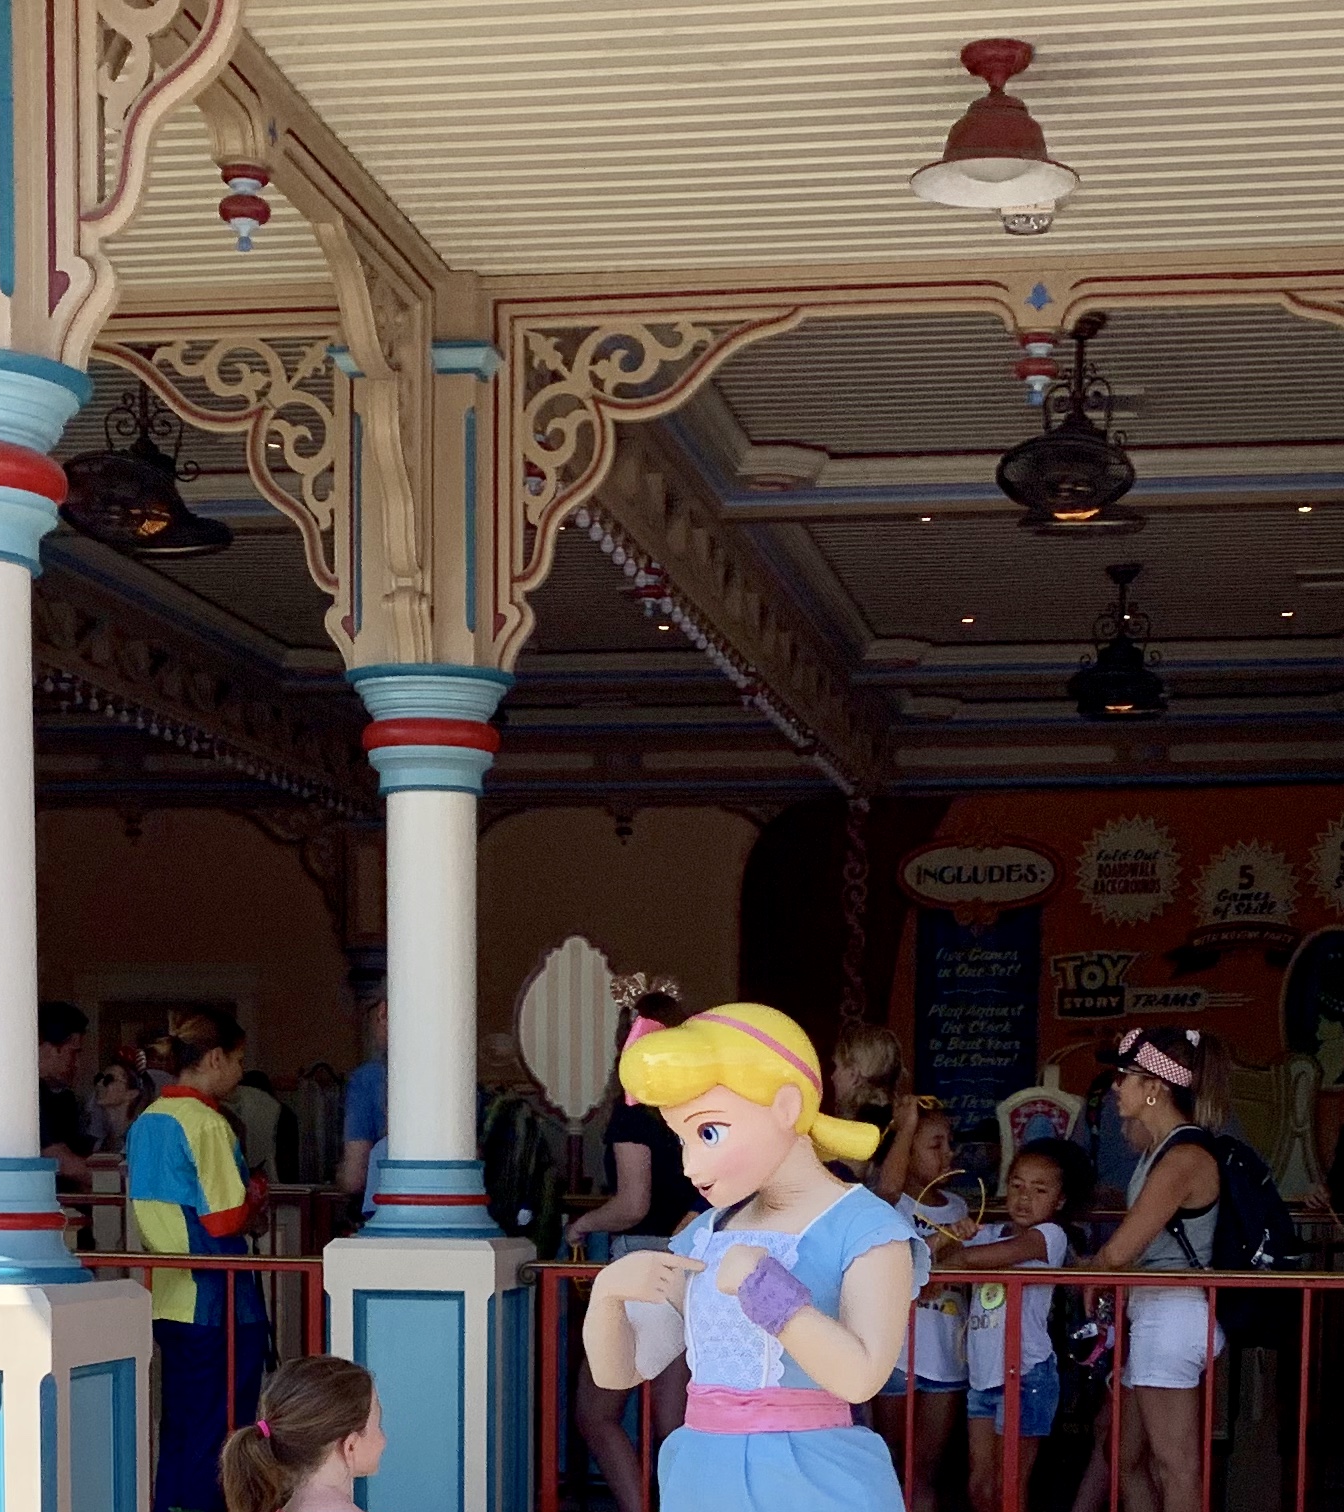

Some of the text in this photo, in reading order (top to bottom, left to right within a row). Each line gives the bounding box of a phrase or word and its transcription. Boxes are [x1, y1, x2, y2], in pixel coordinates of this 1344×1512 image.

[916, 863, 1046, 885] INCLUDES:
[1237, 865, 1255, 890] 5
[1217, 889, 1272, 902] Games
[1212, 901, 1278, 919] of Skill
[1056, 955, 1130, 990] TOY
[1062, 996, 1121, 1009] STORY
[1132, 992, 1201, 1008] TRAMS
